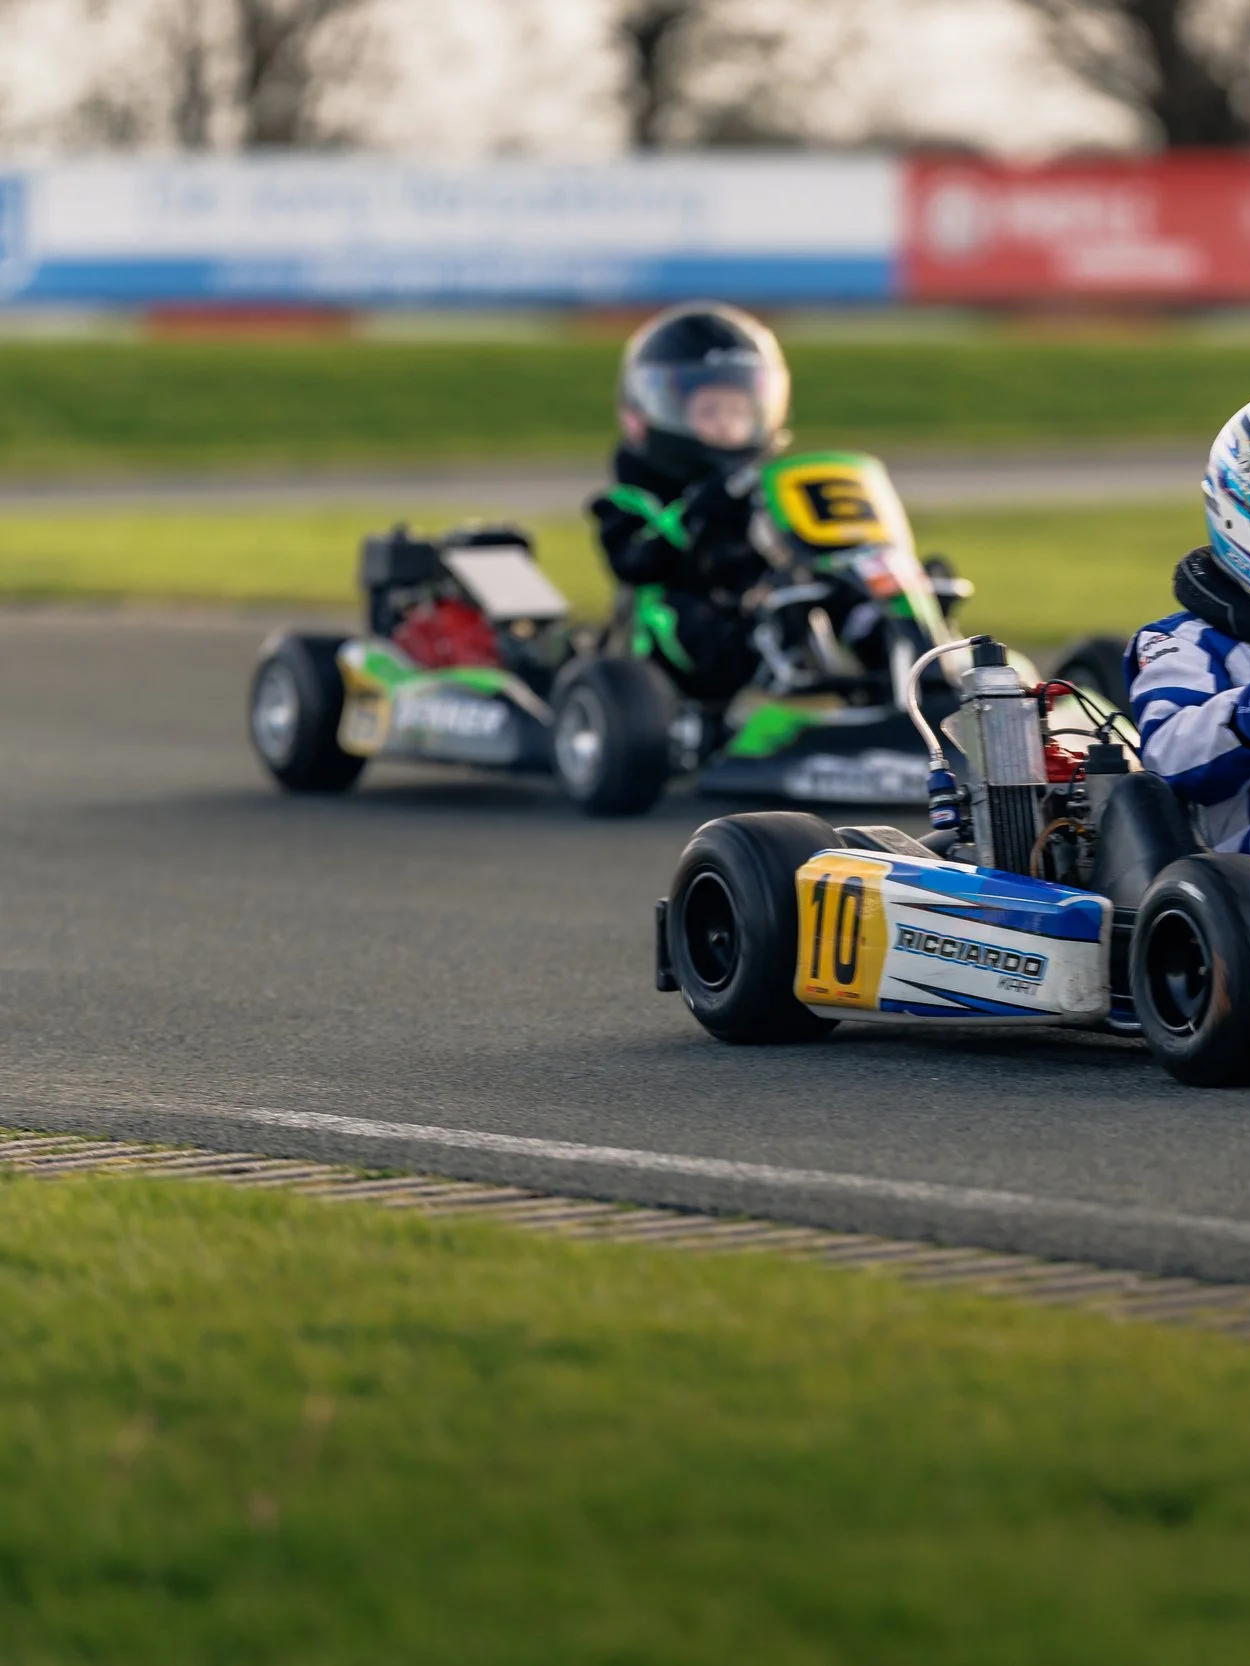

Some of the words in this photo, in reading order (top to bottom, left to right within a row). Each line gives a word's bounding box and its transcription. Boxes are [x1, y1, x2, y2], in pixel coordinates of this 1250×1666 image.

[798, 477, 878, 521] 6
[811, 873, 863, 985] 10
[894, 923, 1048, 981] RICCIARDO
[996, 974, 1043, 997] KART
